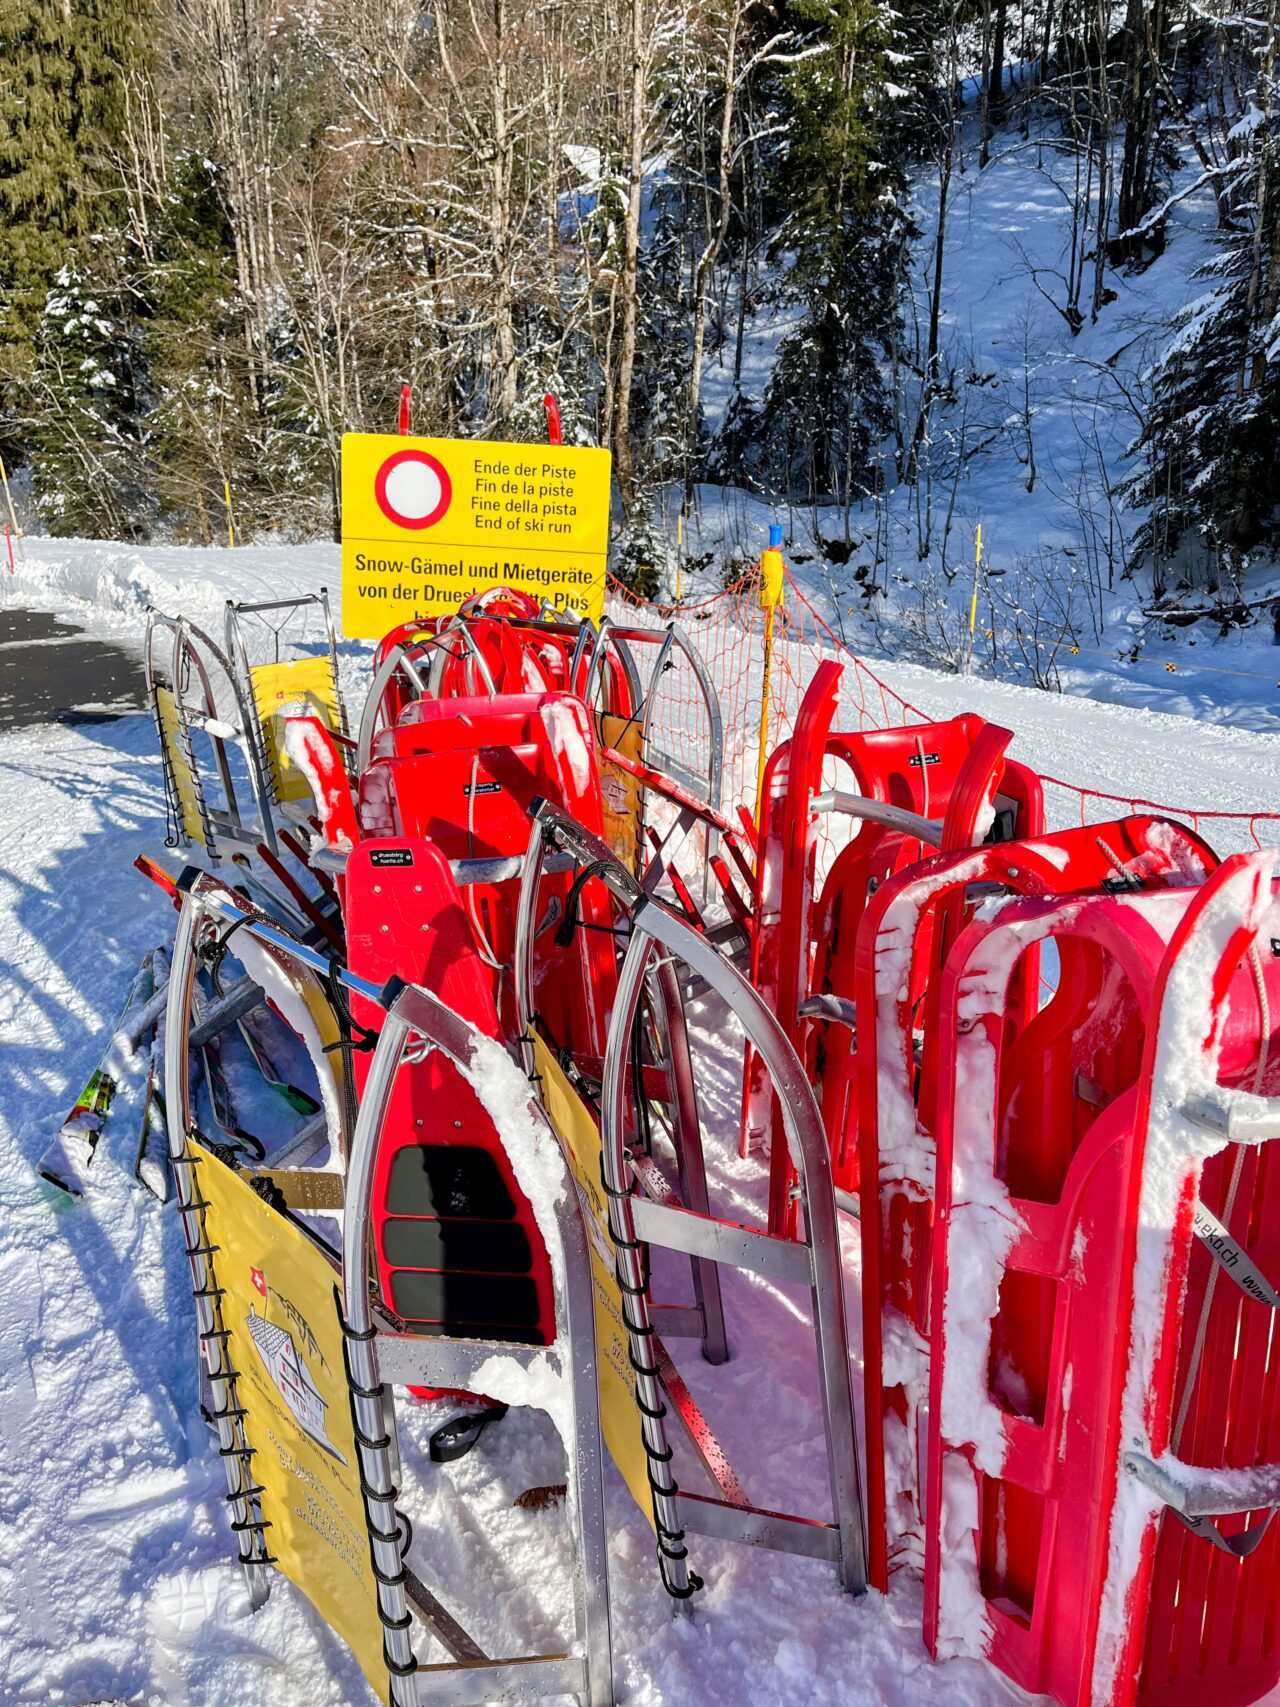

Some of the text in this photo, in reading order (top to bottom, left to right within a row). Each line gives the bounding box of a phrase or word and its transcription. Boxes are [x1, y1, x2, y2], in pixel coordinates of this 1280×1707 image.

[474, 460, 577, 479] Ende der Piste
[475, 479, 574, 499] Fin de la piste
[471, 497, 577, 516] Fine della pista
[475, 515, 572, 534] End of ski run
[355, 554, 593, 585] Snow-Gämel und Mietgeräte
[358, 585, 388, 600] von
[392, 583, 419, 602] der
[554, 592, 589, 611] Plus
